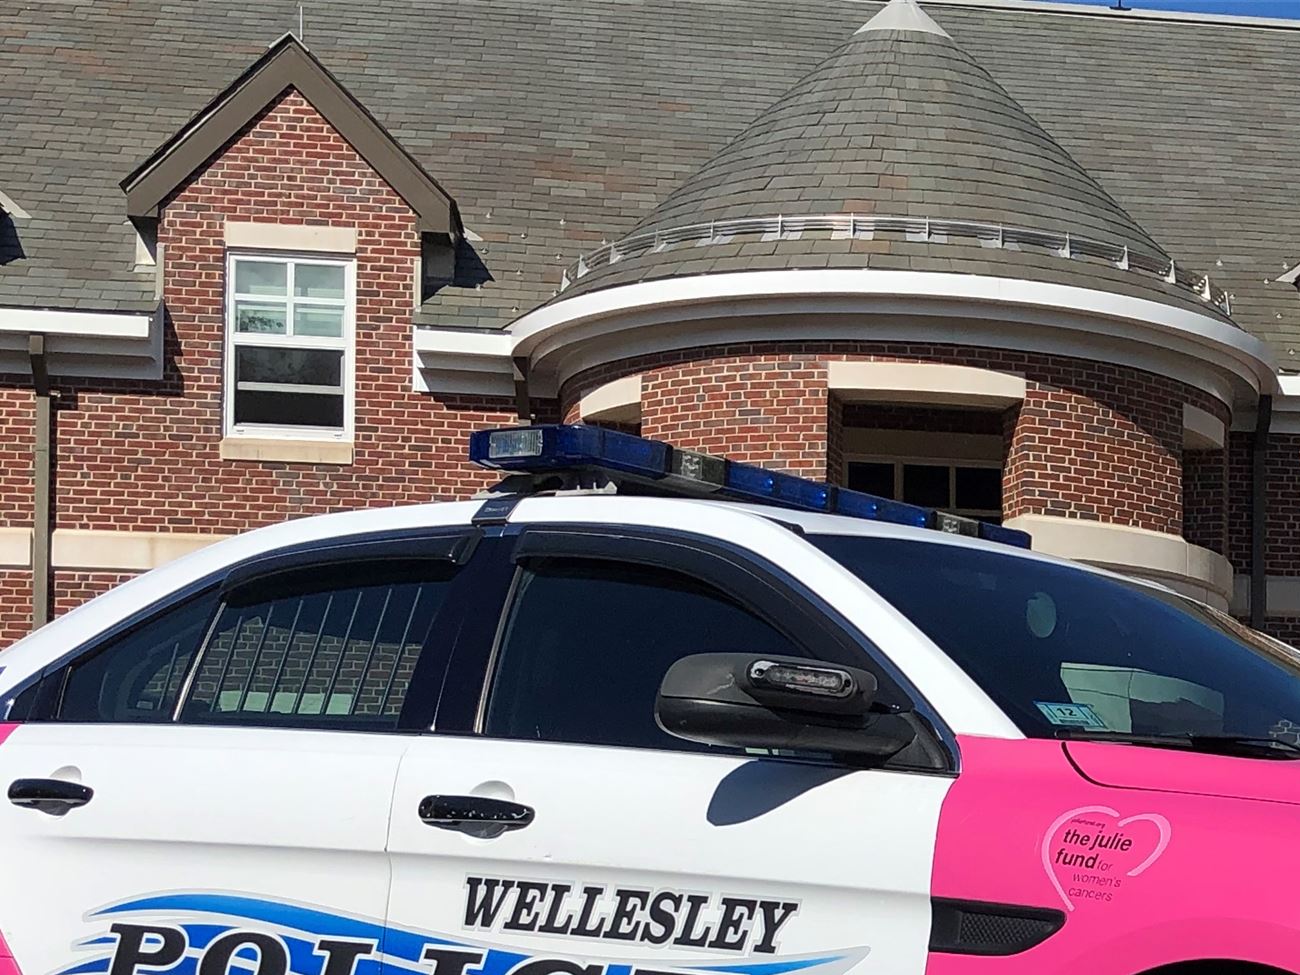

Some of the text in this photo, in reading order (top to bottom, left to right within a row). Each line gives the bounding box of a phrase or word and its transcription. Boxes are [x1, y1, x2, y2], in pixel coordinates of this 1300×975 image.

[1056, 707, 1078, 717] 12
[1063, 829, 1133, 851] the julie
[1055, 848, 1114, 872] fund for
[1072, 873, 1122, 888] women's
[1068, 887, 1113, 902] cancers
[463, 876, 799, 955] WELLESLEY
